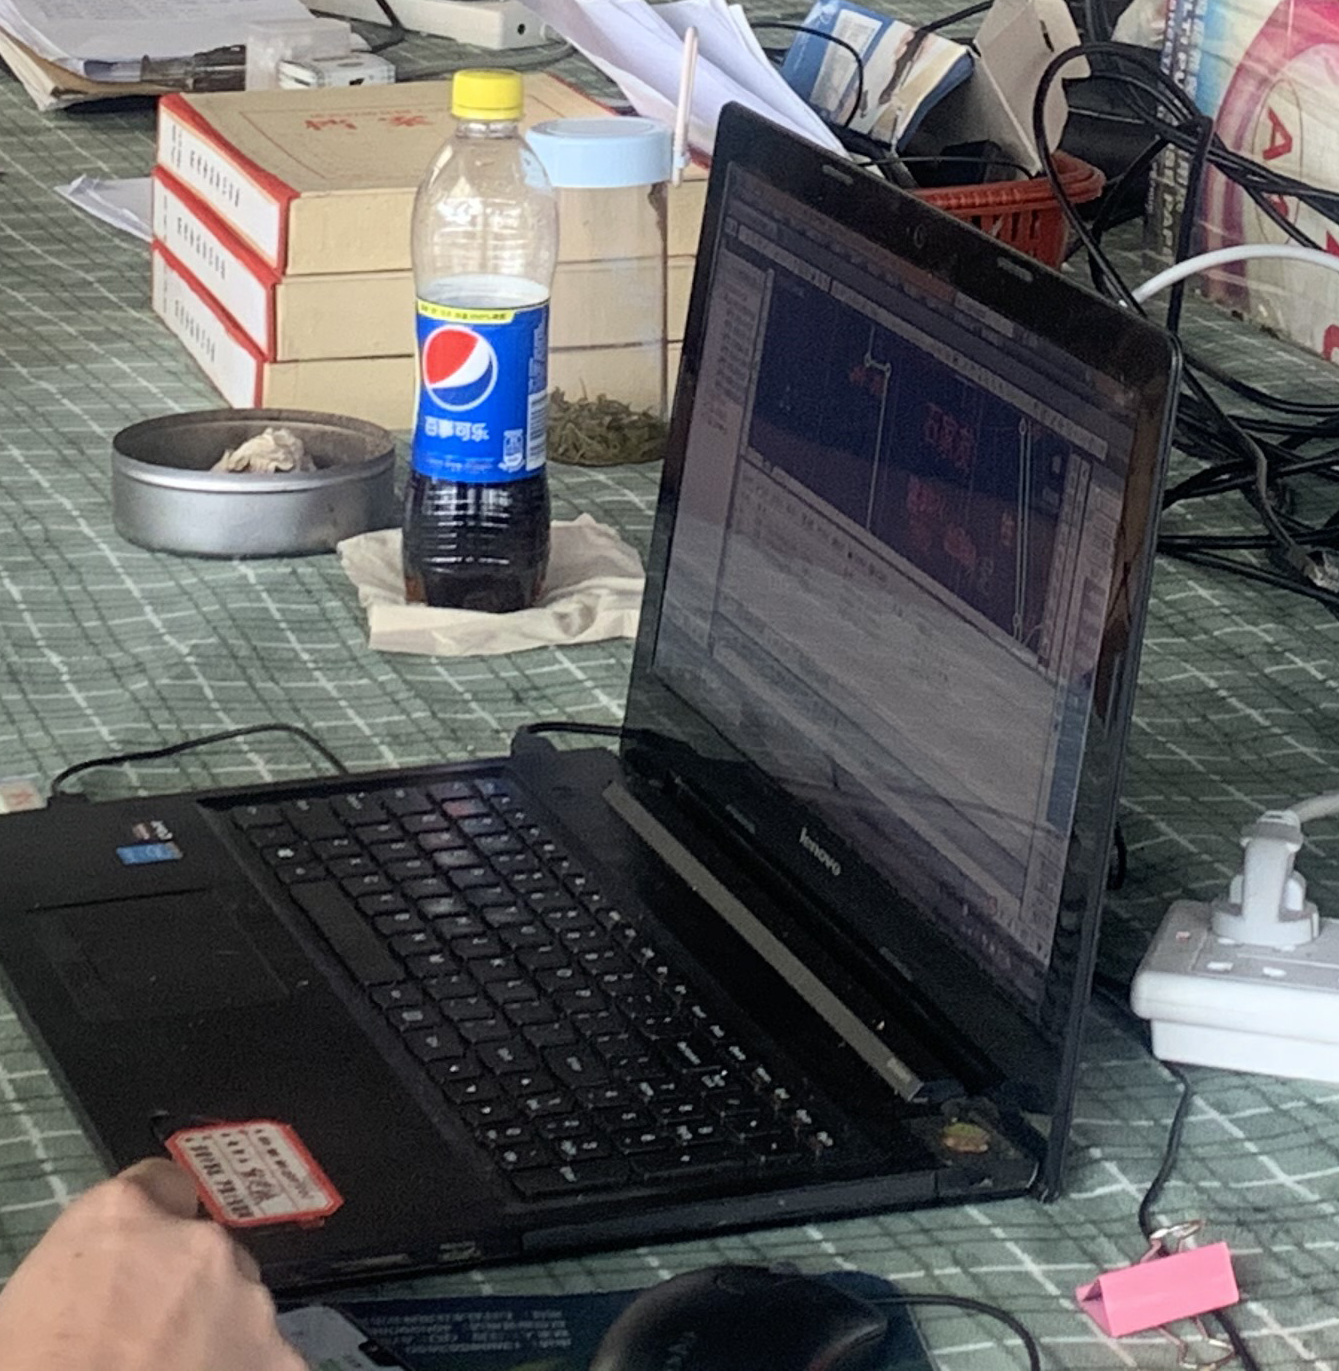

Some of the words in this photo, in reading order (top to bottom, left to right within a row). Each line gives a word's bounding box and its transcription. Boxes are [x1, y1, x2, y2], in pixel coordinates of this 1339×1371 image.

[424, 416, 490, 443] 百事可乐
[799, 825, 842, 877] lenovo
